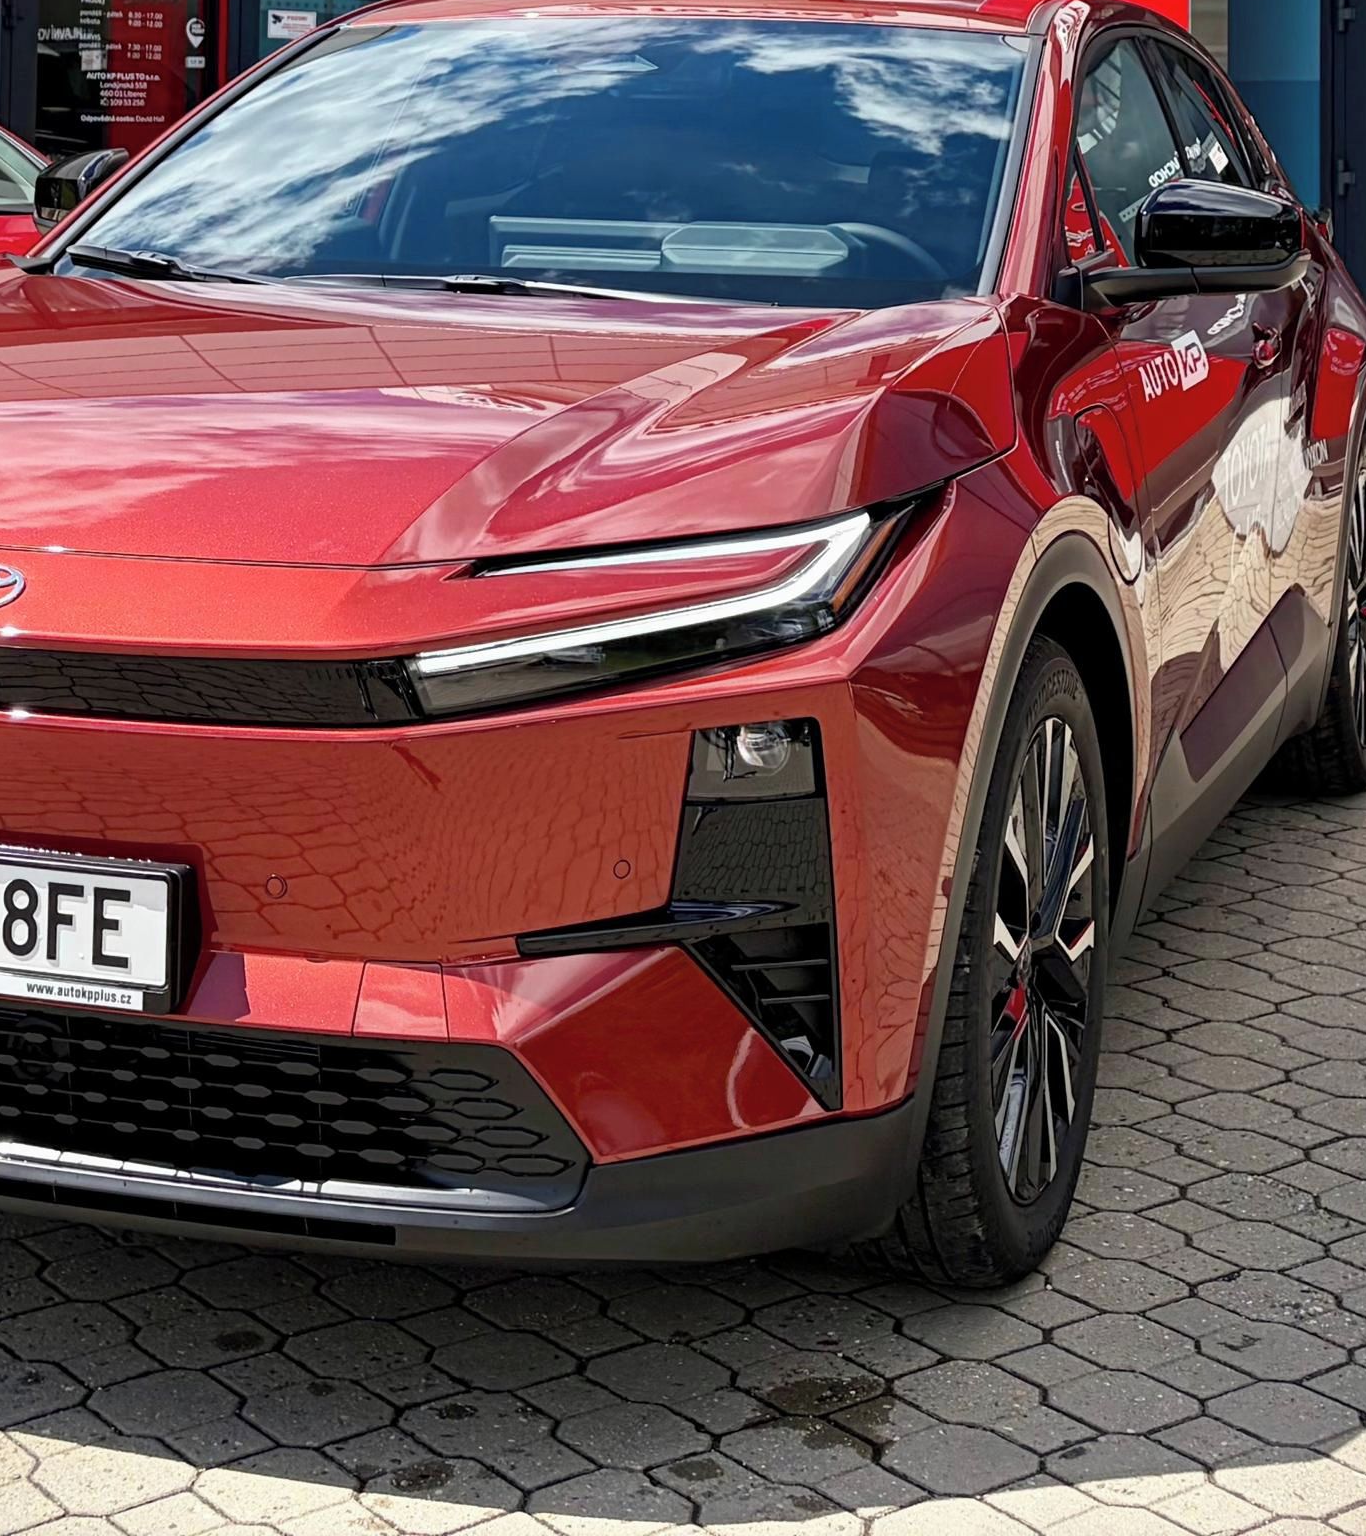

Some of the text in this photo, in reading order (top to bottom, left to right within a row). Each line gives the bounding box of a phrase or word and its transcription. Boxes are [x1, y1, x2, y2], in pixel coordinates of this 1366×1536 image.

[86, 72, 106, 80] AUTO
[1138, 351, 1179, 403] AUTO
[26, 981, 133, 1006] www.autokpplus.cz
